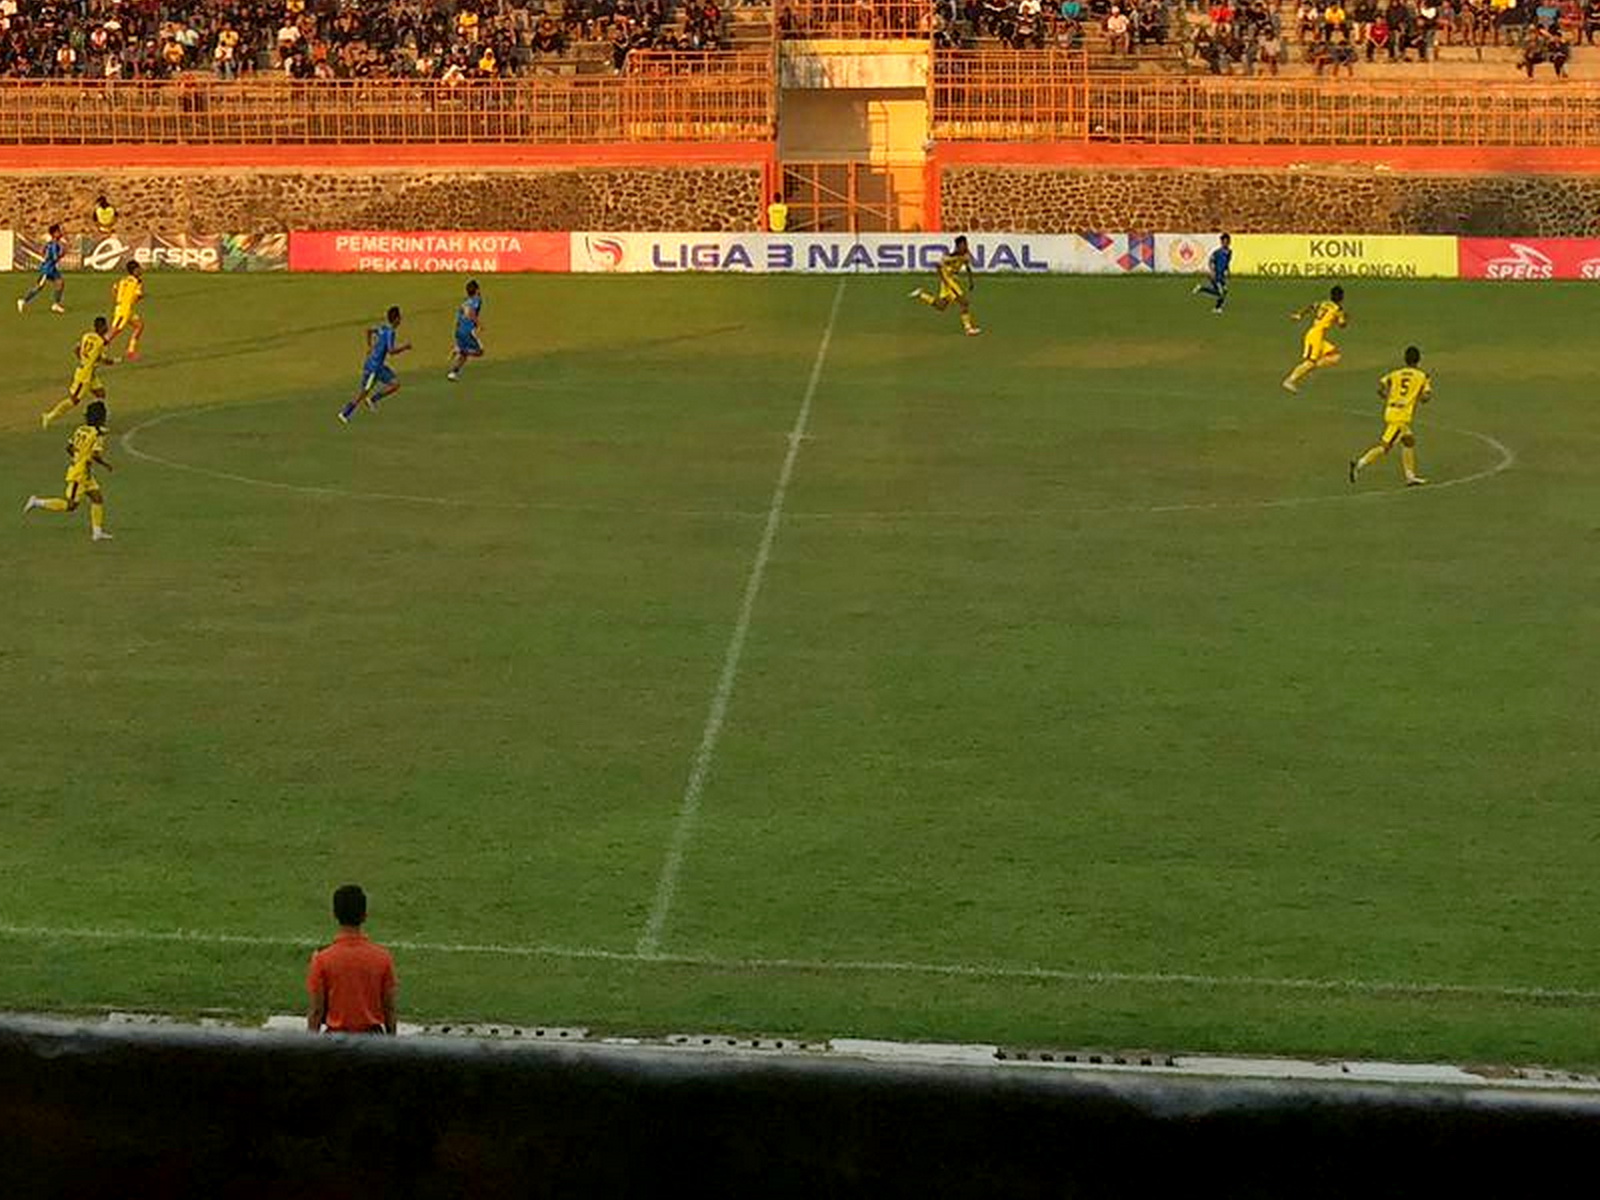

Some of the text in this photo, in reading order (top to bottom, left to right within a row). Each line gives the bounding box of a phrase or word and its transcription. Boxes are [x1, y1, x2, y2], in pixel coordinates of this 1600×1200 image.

[336, 236, 522, 253] PEMERINTAH KOTA
[1310, 240, 1363, 258] KONI
[652, 243, 753, 269] LIGA
[767, 243, 794, 269] 3
[1257, 263, 1300, 277] KOTA
[1486, 264, 1553, 279] SPECS
